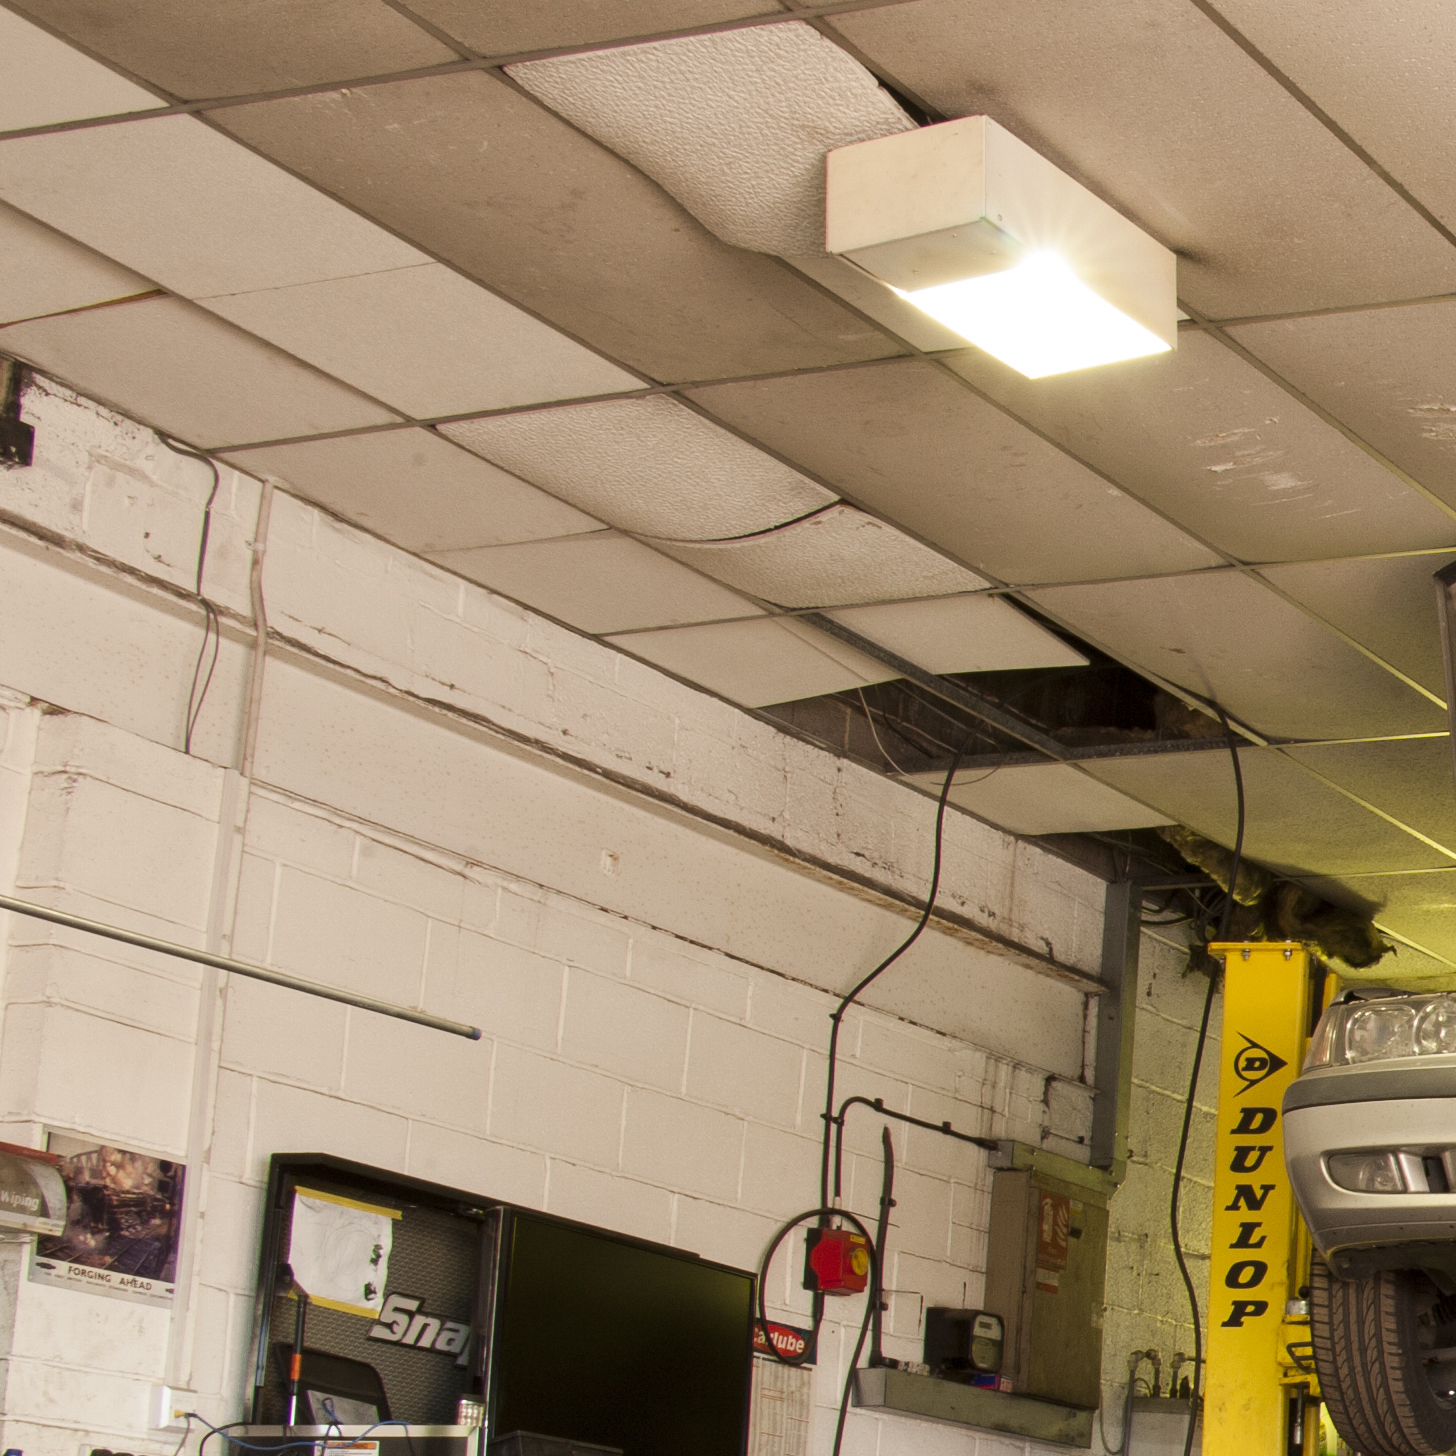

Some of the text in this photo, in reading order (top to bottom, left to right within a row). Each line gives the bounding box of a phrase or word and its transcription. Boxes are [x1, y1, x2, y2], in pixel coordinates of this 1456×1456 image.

[67, 1265, 112, 1283] FORGING
[118, 1276, 153, 1291] AHEAD
[1221, 1107, 1277, 1327] DUNLOP
